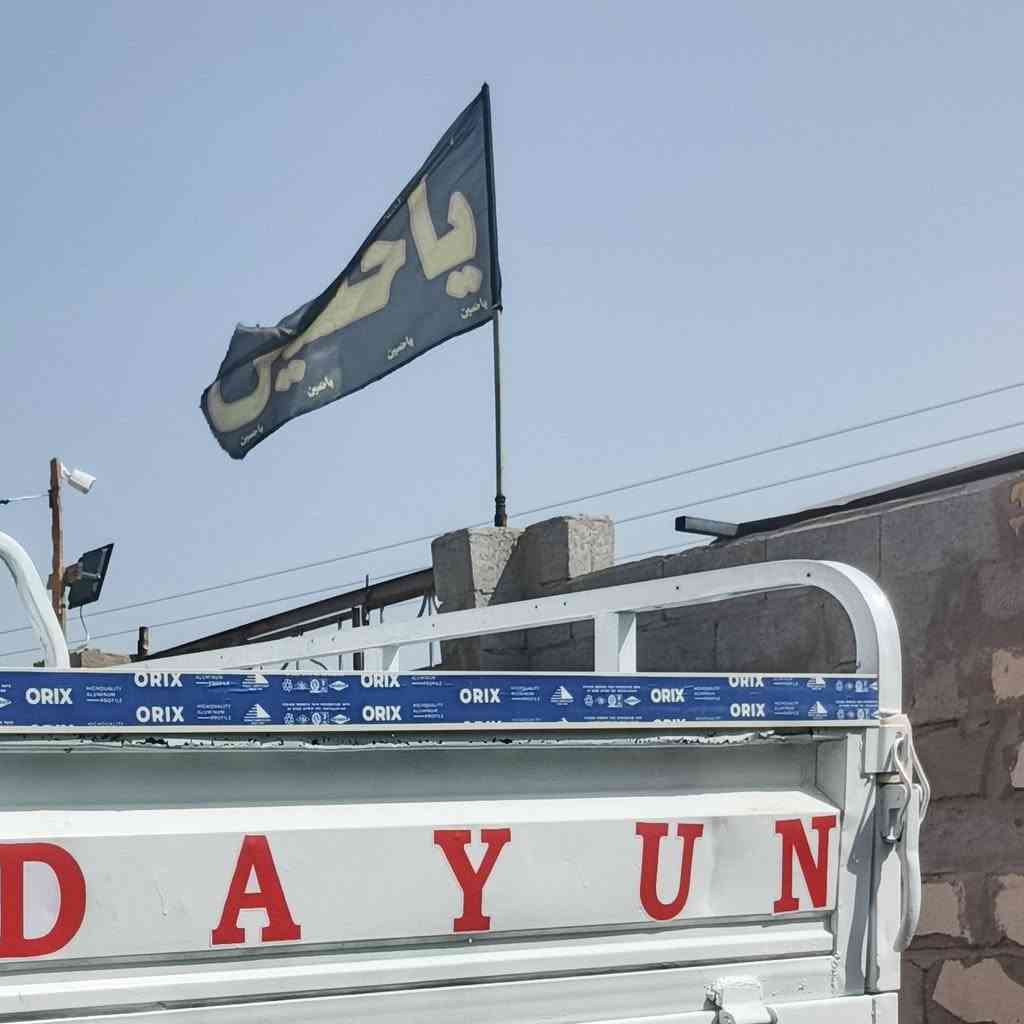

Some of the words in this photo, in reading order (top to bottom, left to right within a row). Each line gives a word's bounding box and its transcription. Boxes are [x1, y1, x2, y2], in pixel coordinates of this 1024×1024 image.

[134, 673, 183, 688] ORIX
[360, 673, 401, 688] ORIX
[728, 676, 764, 688] ORIX
[26, 687, 73, 705] ORIX
[459, 688, 501, 704] ORIX
[650, 688, 685, 703] ORIX
[135, 706, 185, 723] ORIX
[362, 705, 402, 722] ORIX
[730, 703, 766, 718] ORIX
